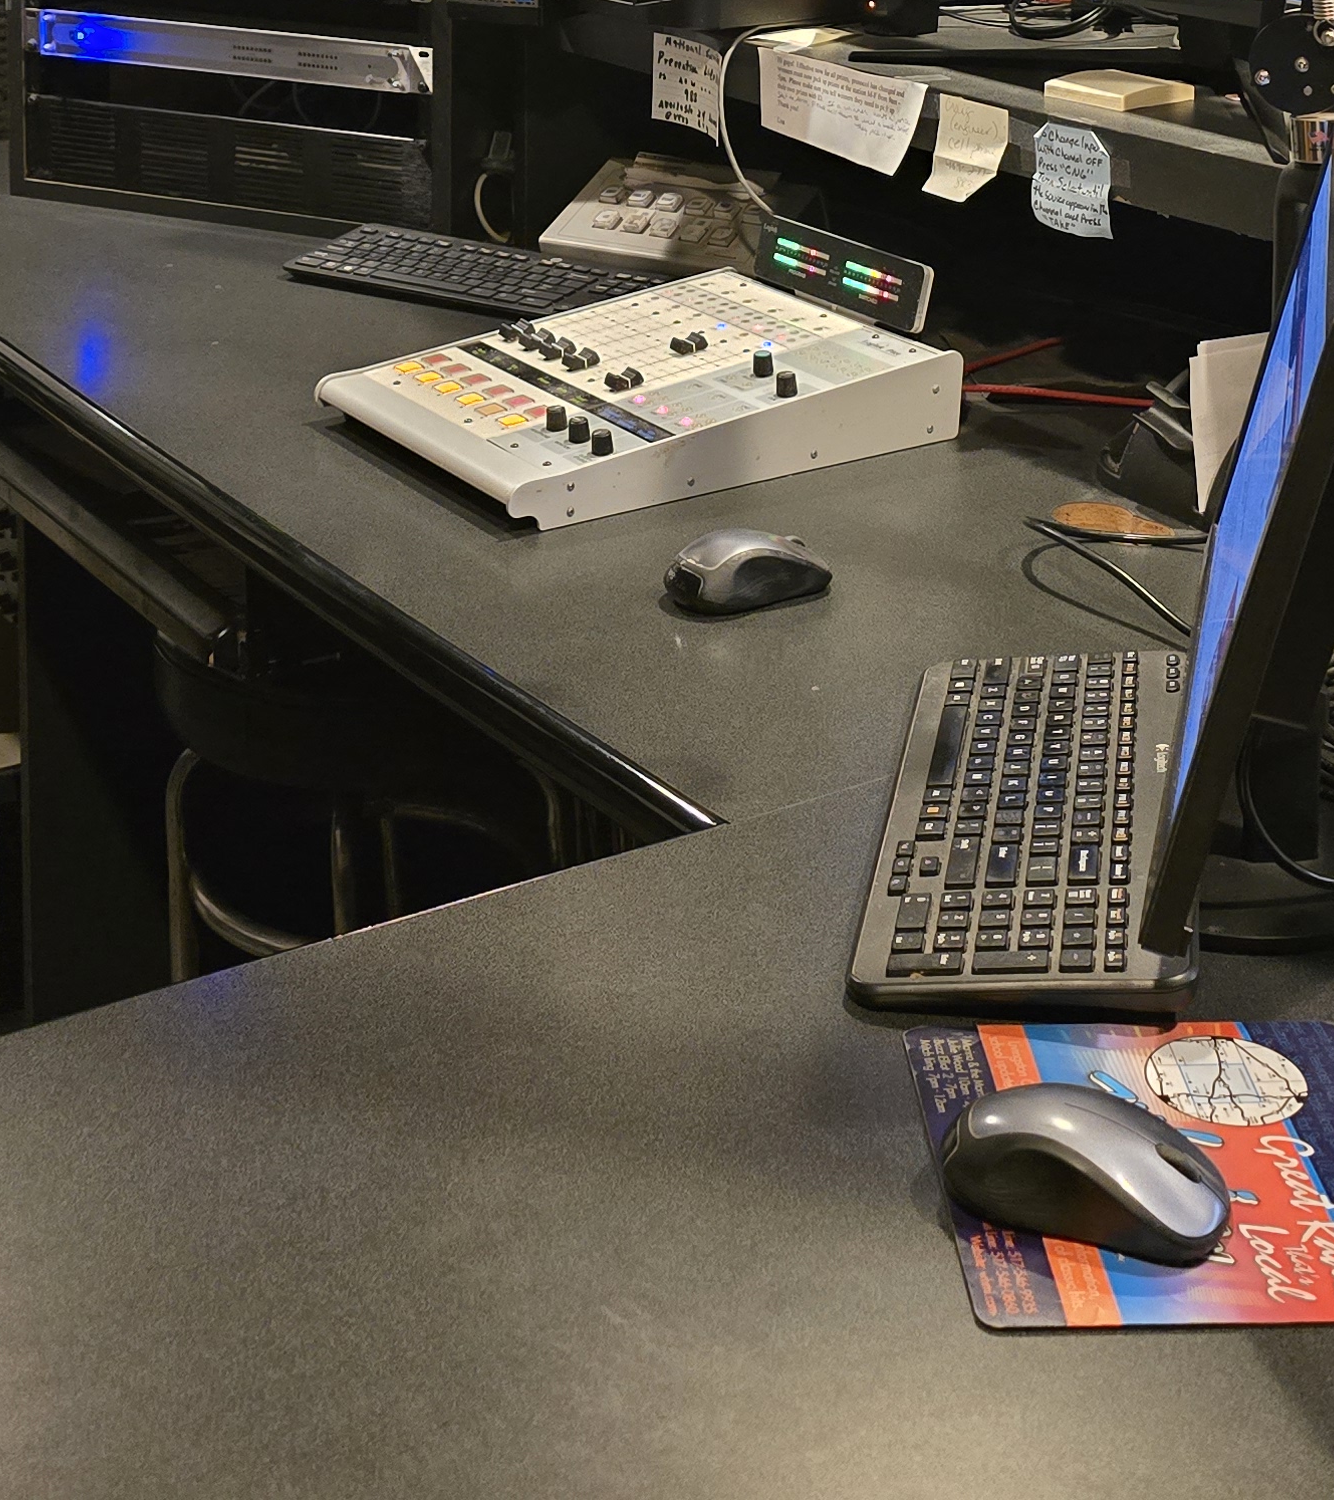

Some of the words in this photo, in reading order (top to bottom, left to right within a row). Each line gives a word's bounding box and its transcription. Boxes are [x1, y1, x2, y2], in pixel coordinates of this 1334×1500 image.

[1086, 156, 1103, 167] OFF
[1238, 1223, 1317, 1304] Local
[1283, 1244, 1321, 1287] That's
